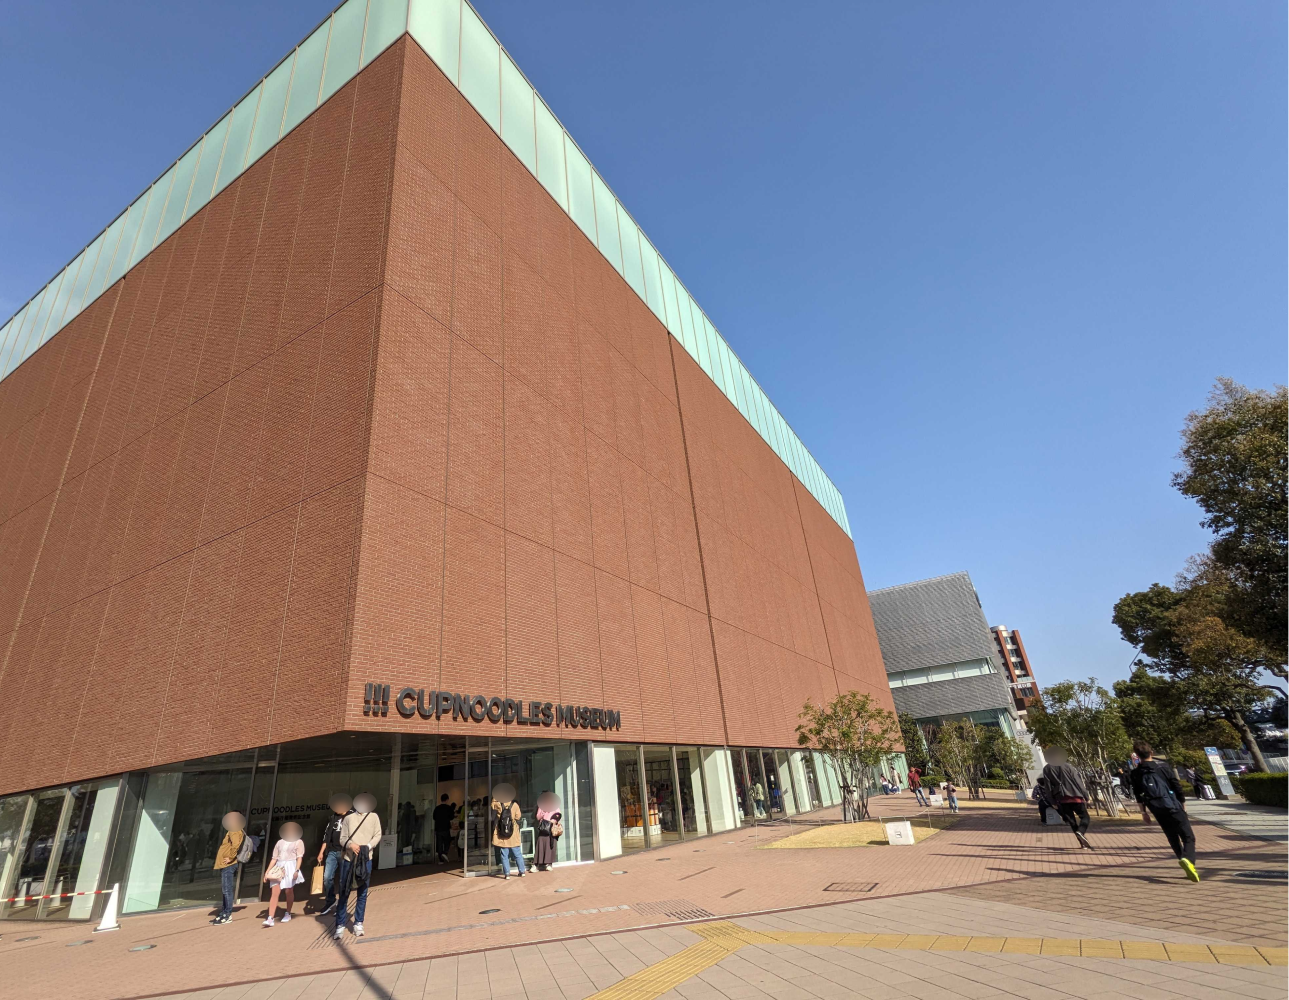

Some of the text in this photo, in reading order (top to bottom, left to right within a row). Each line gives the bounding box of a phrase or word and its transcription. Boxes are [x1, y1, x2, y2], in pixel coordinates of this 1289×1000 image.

[396, 687, 554, 727] CUPNOODLES
[556, 704, 622, 731] MUSEUM
[251, 803, 330, 816] CUPOODLES MUSEU
